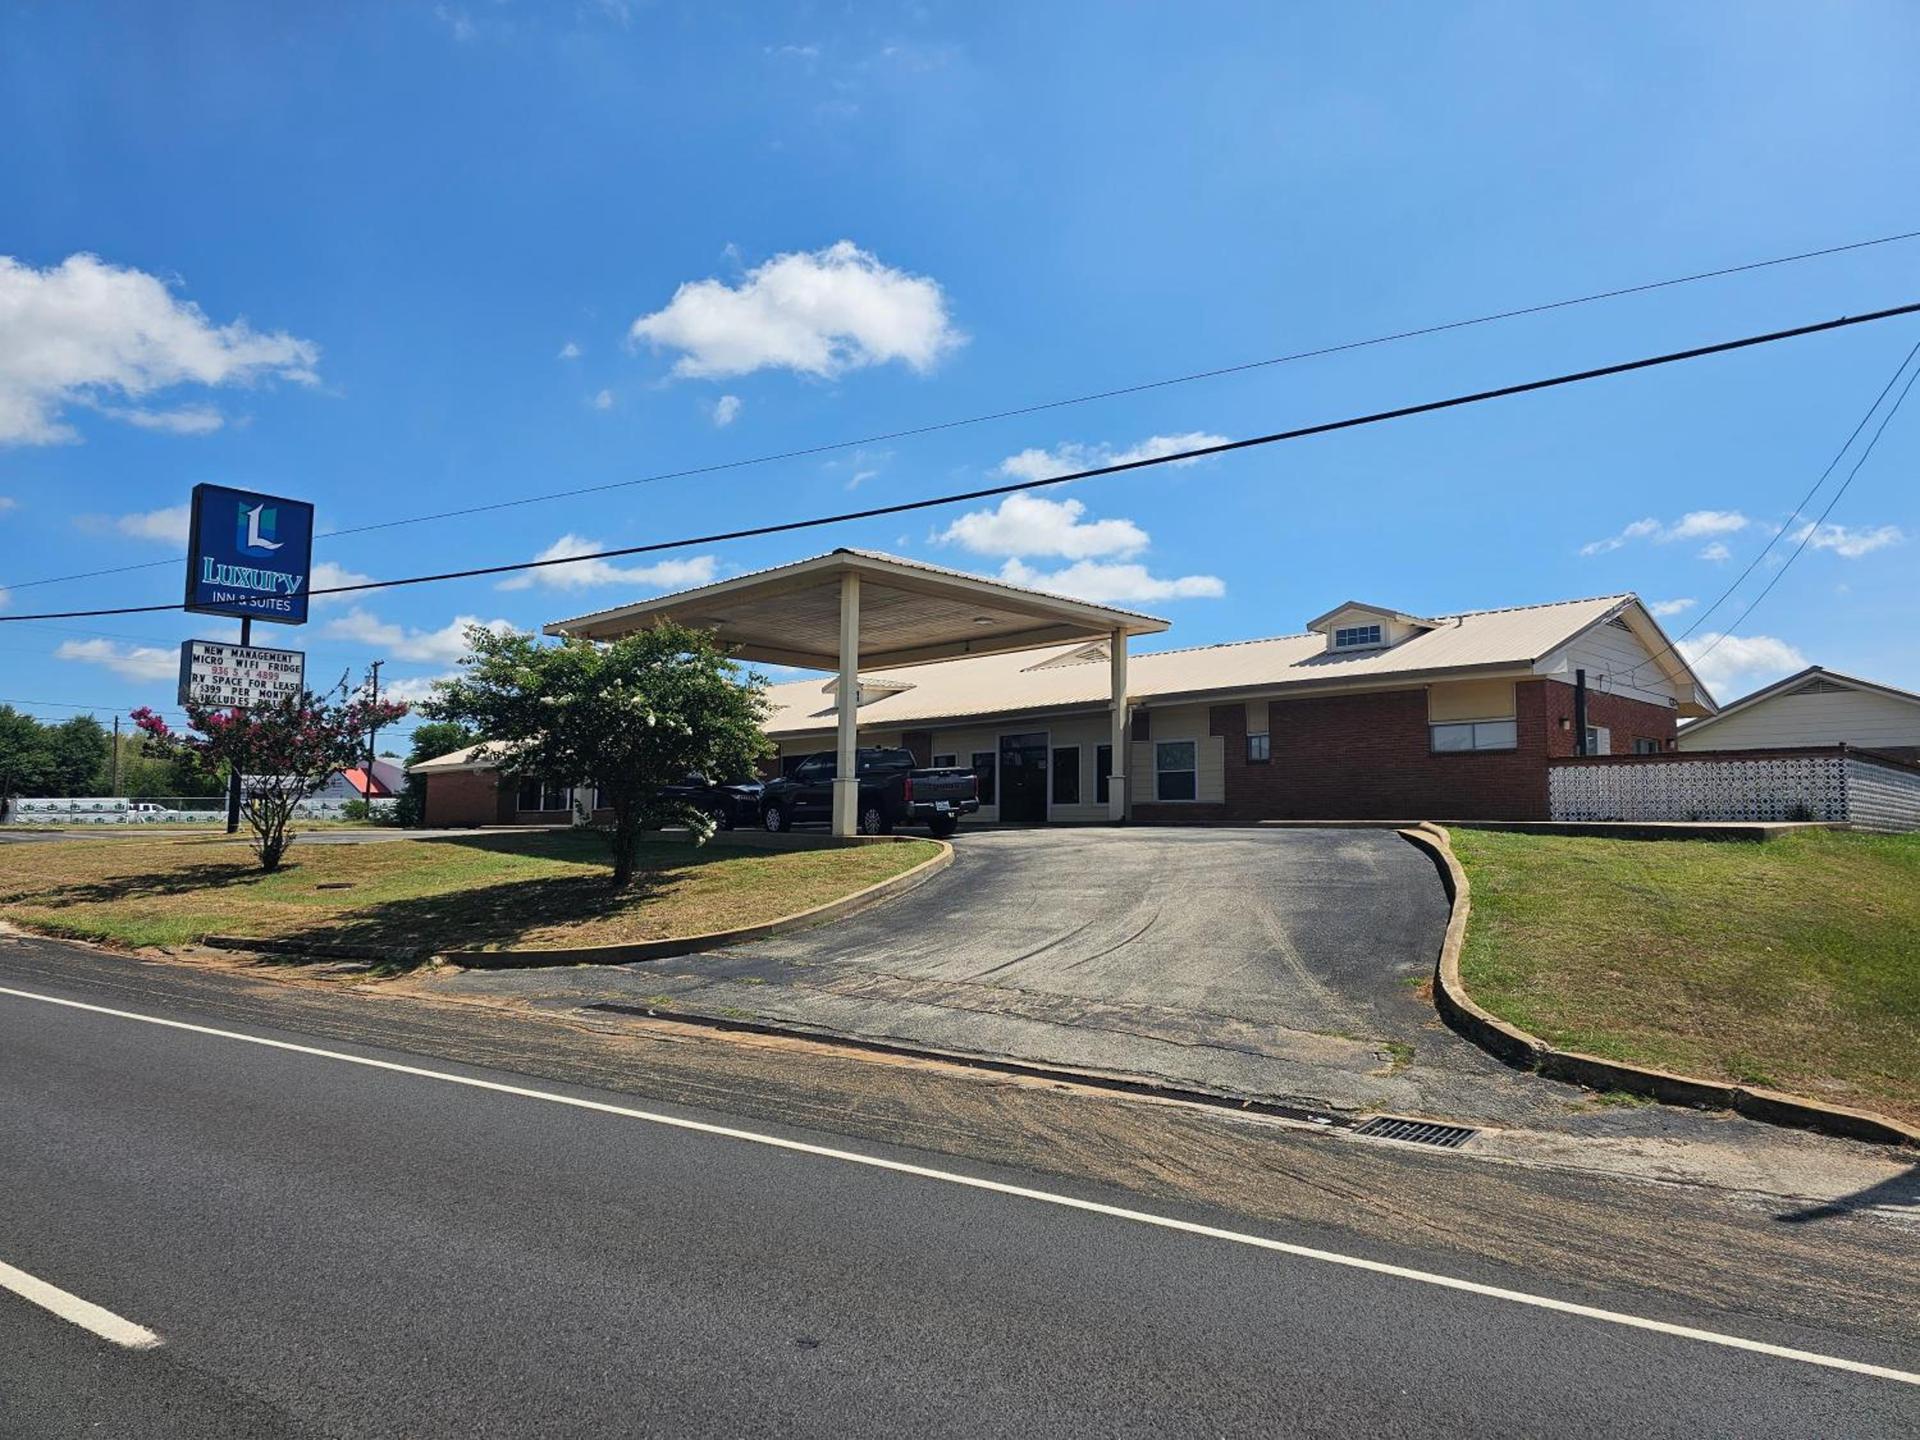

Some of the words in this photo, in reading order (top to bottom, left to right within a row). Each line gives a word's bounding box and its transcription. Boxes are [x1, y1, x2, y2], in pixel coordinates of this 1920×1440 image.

[212, 591, 236, 605] INN
[238, 595, 247, 605] &
[249, 596, 291, 611] SUITES
[204, 646, 224, 656] NEW
[231, 650, 293, 663] MANAGEMENT
[192, 654, 224, 665] MICRO
[236, 660, 259, 669] WIFI
[268, 663, 300, 673] FRIDGE
[192, 673, 206, 683] RV
[212, 676, 243, 687] SPACE
[248, 680, 267, 688] FOR
[273, 682, 300, 691] LEASE
[200, 685, 221, 693] $399
[231, 688, 250, 697] PER
[200, 695, 249, 706] INCLUDES
